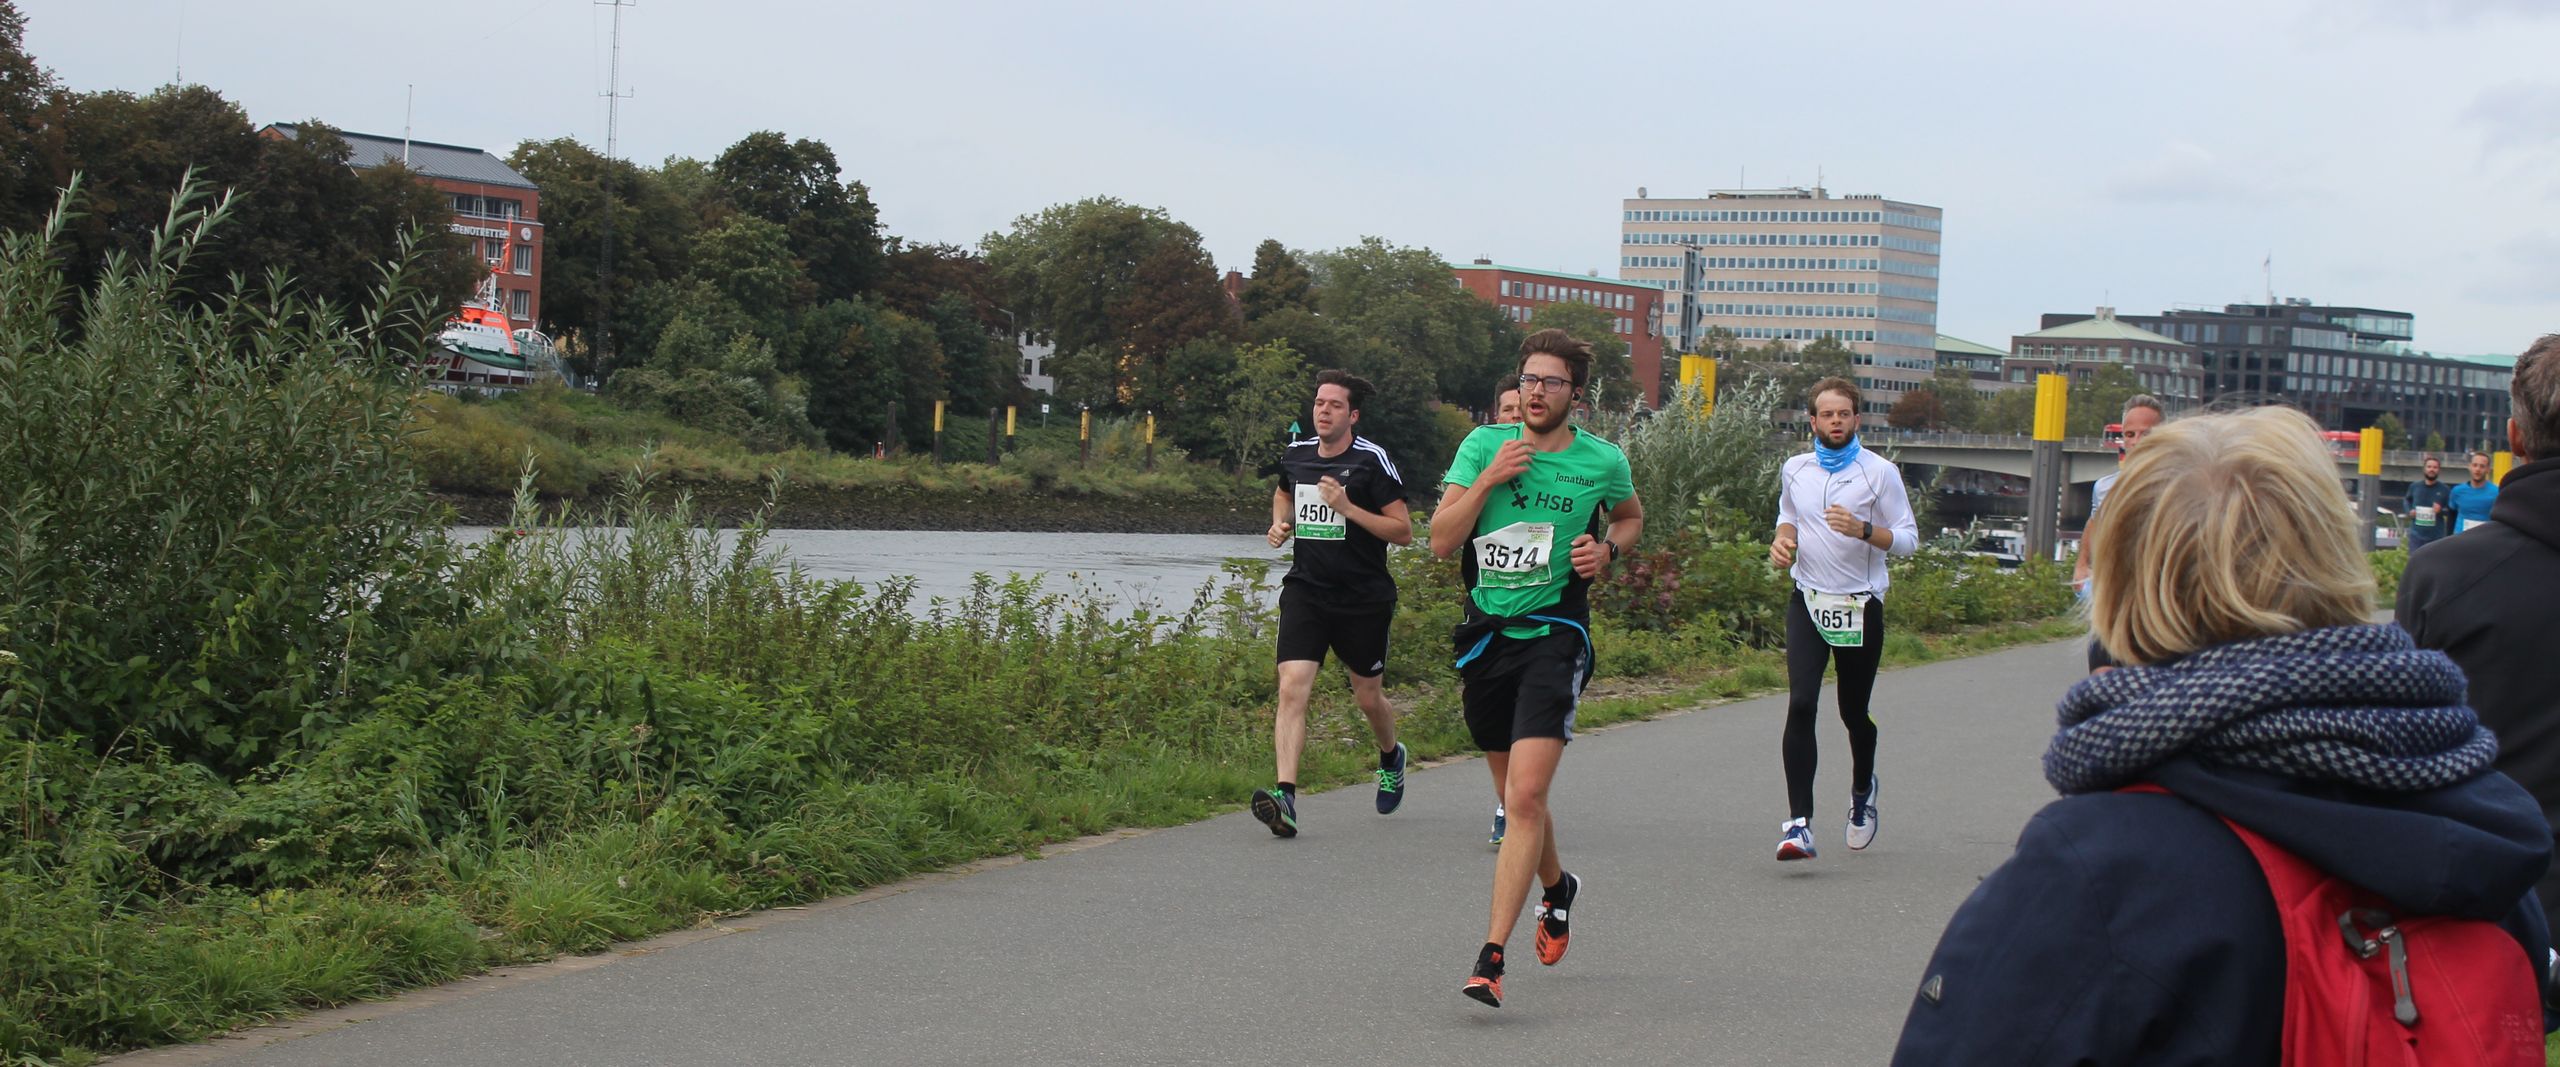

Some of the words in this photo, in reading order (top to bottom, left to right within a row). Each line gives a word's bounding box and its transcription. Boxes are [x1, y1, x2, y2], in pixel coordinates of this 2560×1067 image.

[1554, 472, 1596, 487] Jonathan
[1534, 491, 1574, 513] HSB
[1484, 543, 1539, 568] 3514
